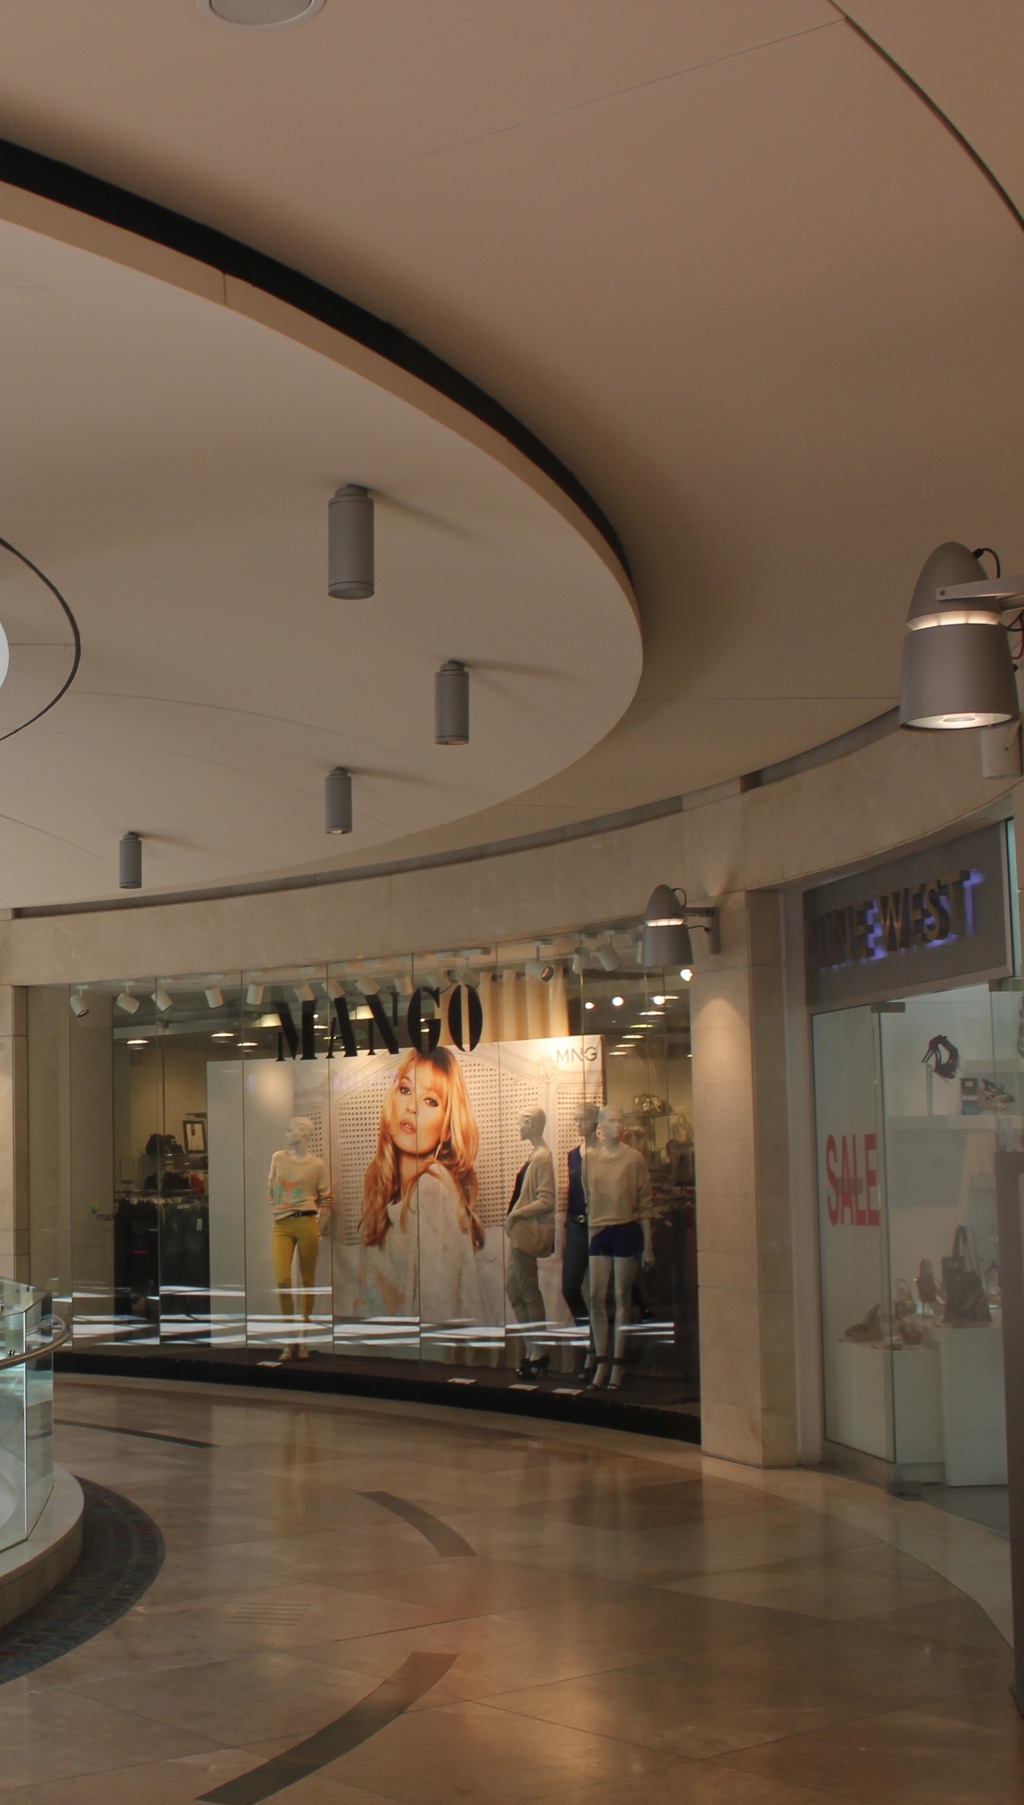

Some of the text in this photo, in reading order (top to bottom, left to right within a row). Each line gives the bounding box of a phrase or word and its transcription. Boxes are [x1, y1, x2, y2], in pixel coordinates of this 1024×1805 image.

[878, 870, 971, 951] WEST
[275, 984, 483, 1061] MANGO
[556, 1046, 598, 1063] MNG
[826, 1133, 880, 1227] SALE
